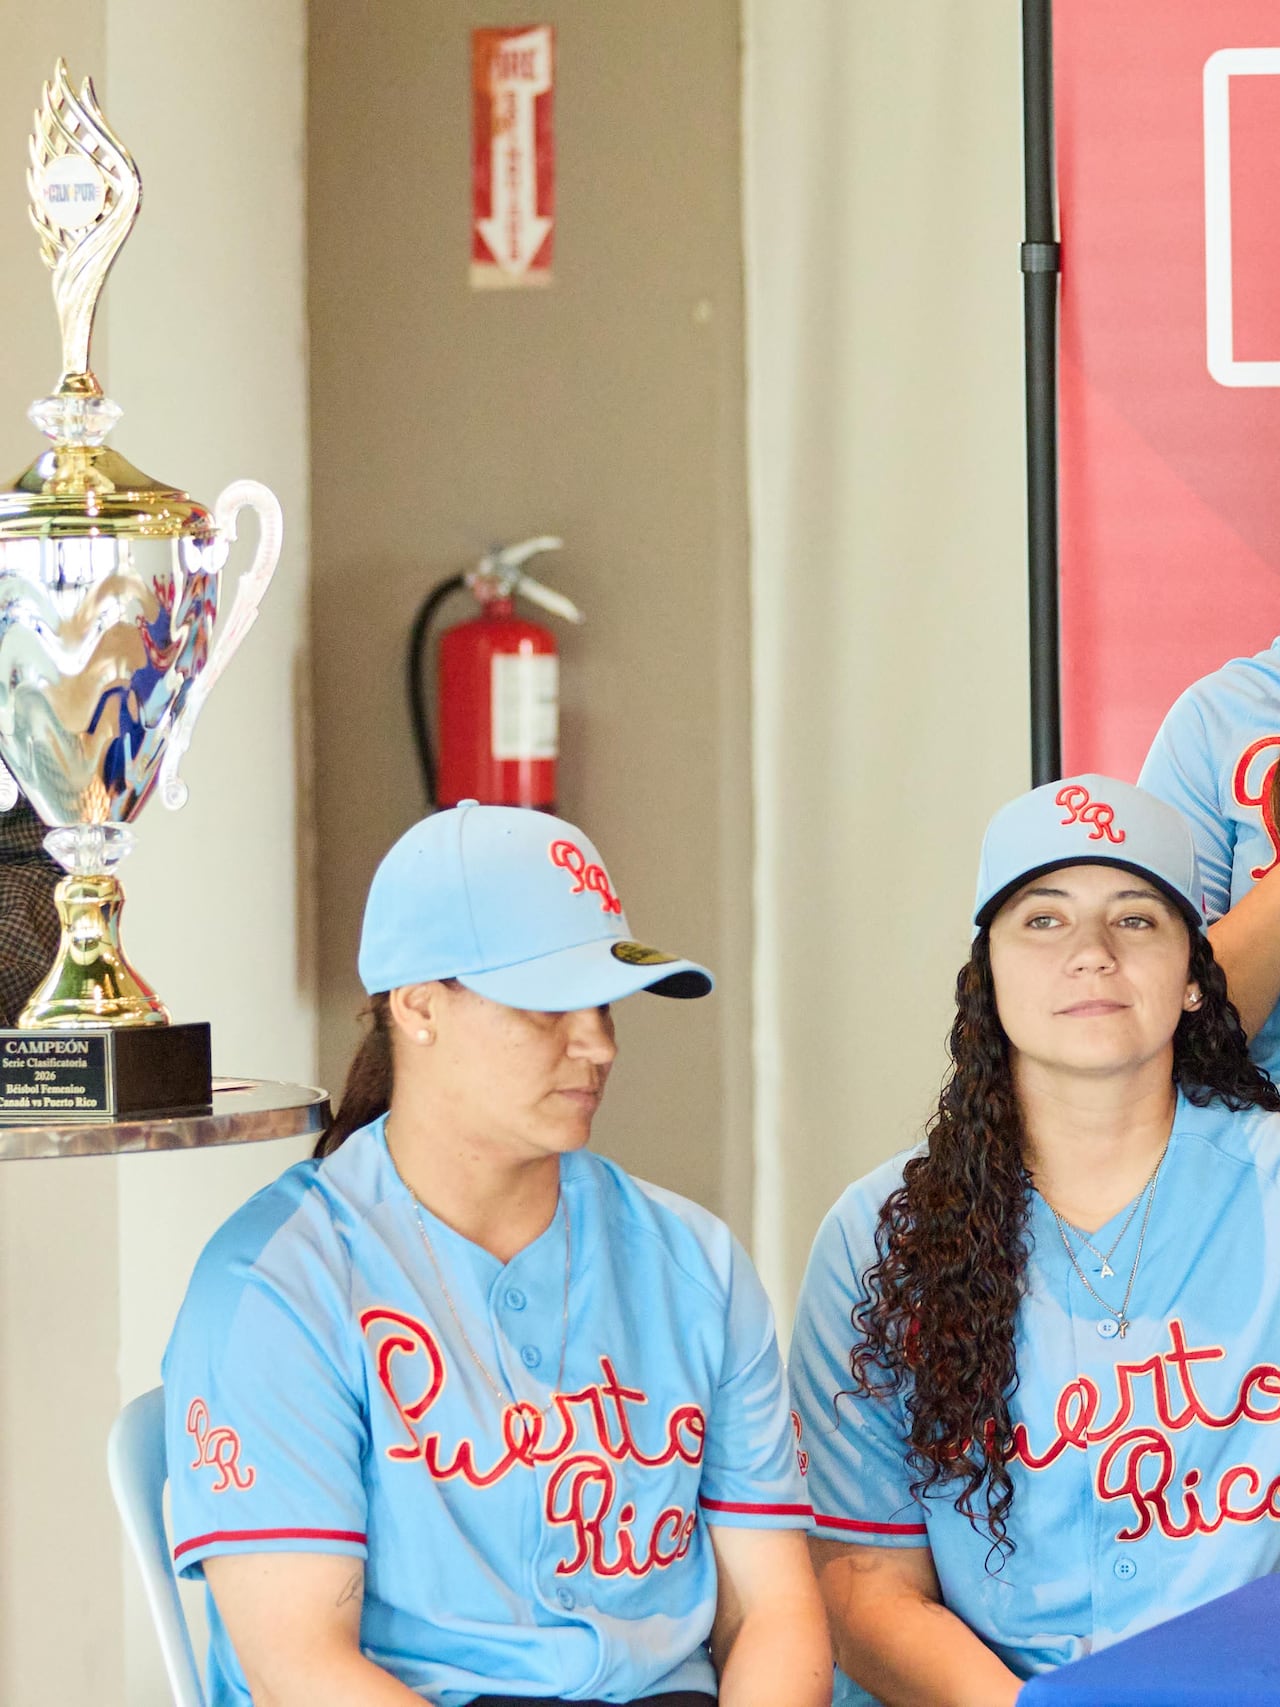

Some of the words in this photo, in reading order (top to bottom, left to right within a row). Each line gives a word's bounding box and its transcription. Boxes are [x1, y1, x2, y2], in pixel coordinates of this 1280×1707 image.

[5, 1038, 90, 1054] CAMPEÓN
[2, 1058, 25, 1068] Serie
[27, 1057, 88, 1068] Clasificatoria
[34, 1071, 57, 1081] 2026
[6, 1084, 39, 1094] Béisbol
[41, 1084, 86, 1094] Femenino
[43, 1097, 74, 1107] Puerto
[75, 1097, 97, 1107] Rico
[358, 1307, 706, 1490] Puerto
